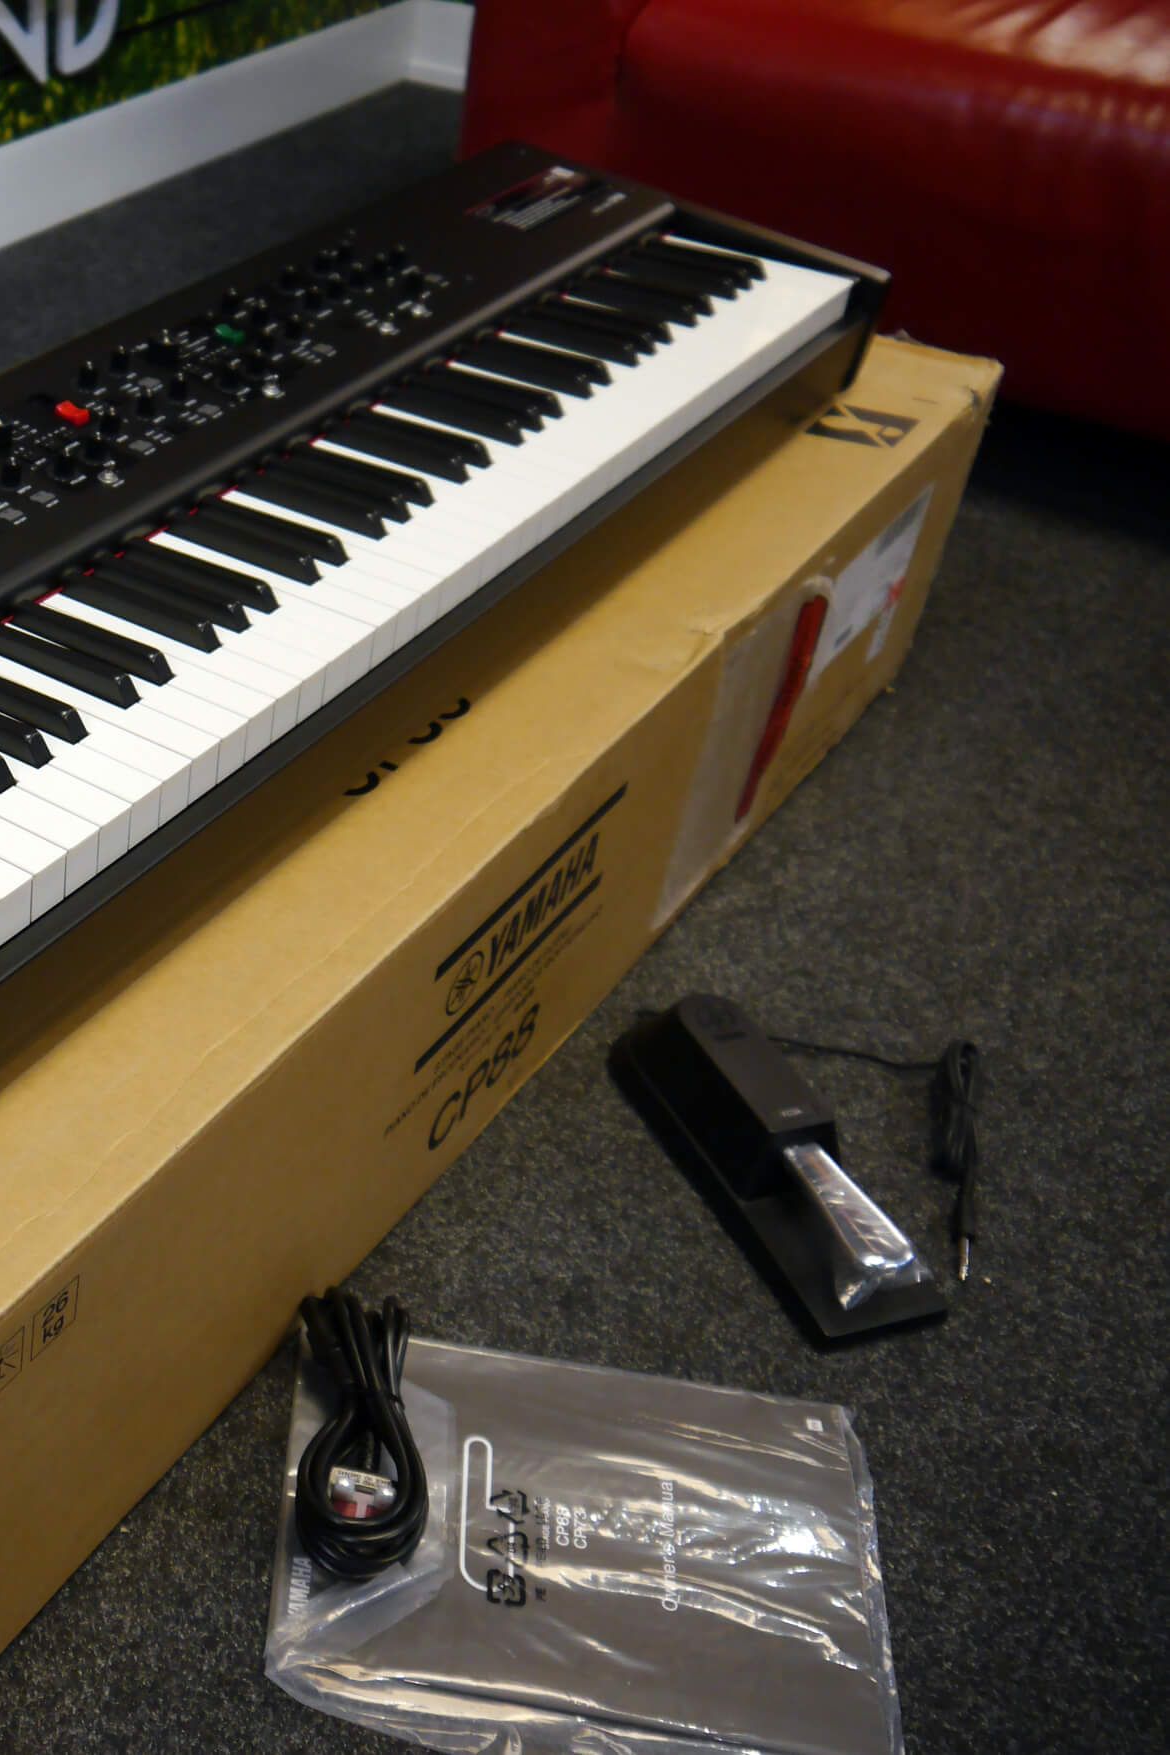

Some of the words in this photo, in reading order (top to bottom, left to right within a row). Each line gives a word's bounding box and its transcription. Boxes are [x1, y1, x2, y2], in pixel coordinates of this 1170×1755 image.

[487, 832, 599, 978] YAMAHA
[428, 1003, 540, 1151] CP88
[42, 1290, 69, 1329] 26
[42, 1315, 65, 1345] kg
[556, 1506, 571, 1547] CP88
[660, 1477, 675, 1538] Manua
[573, 1510, 588, 1550] CP73
